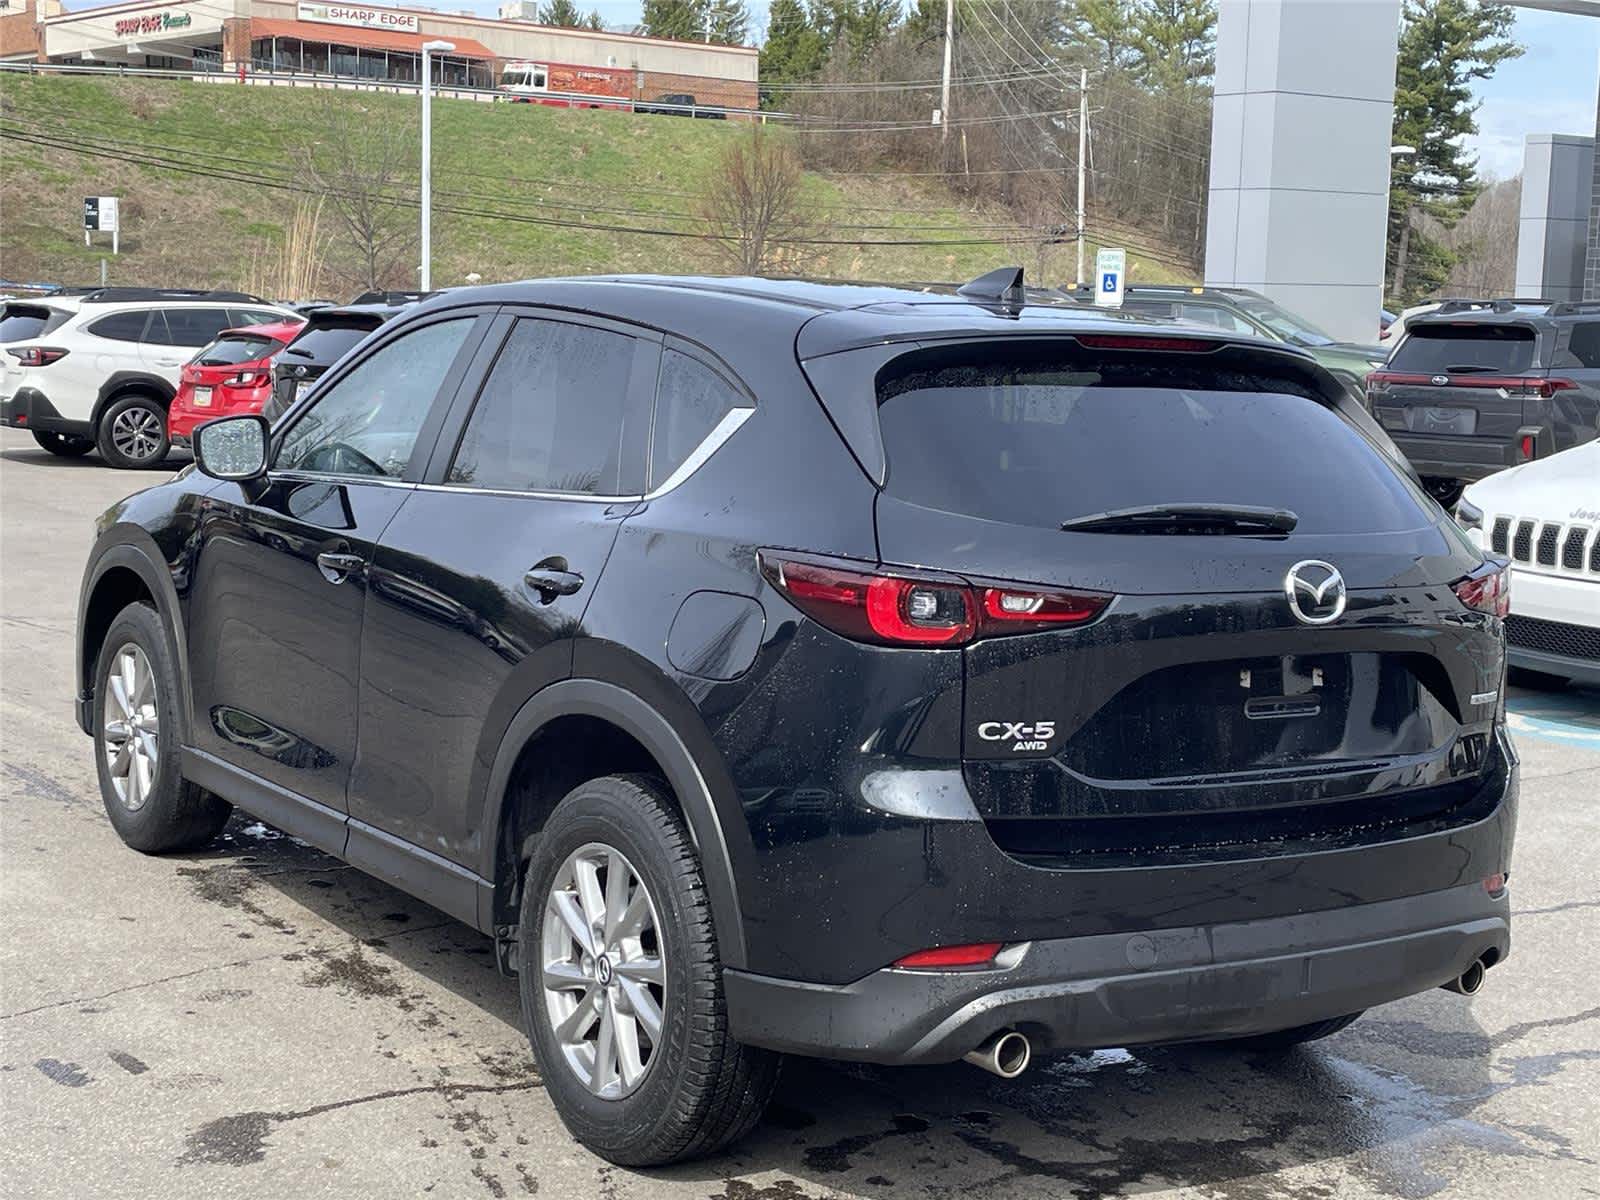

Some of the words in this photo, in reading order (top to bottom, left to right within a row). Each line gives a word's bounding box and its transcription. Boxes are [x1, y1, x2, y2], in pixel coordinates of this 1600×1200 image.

[330, 8, 375, 21] SHARP
[381, 13, 414, 27] EDGE
[978, 721, 1055, 740] CX-5
[1013, 741, 1048, 752] AWD
